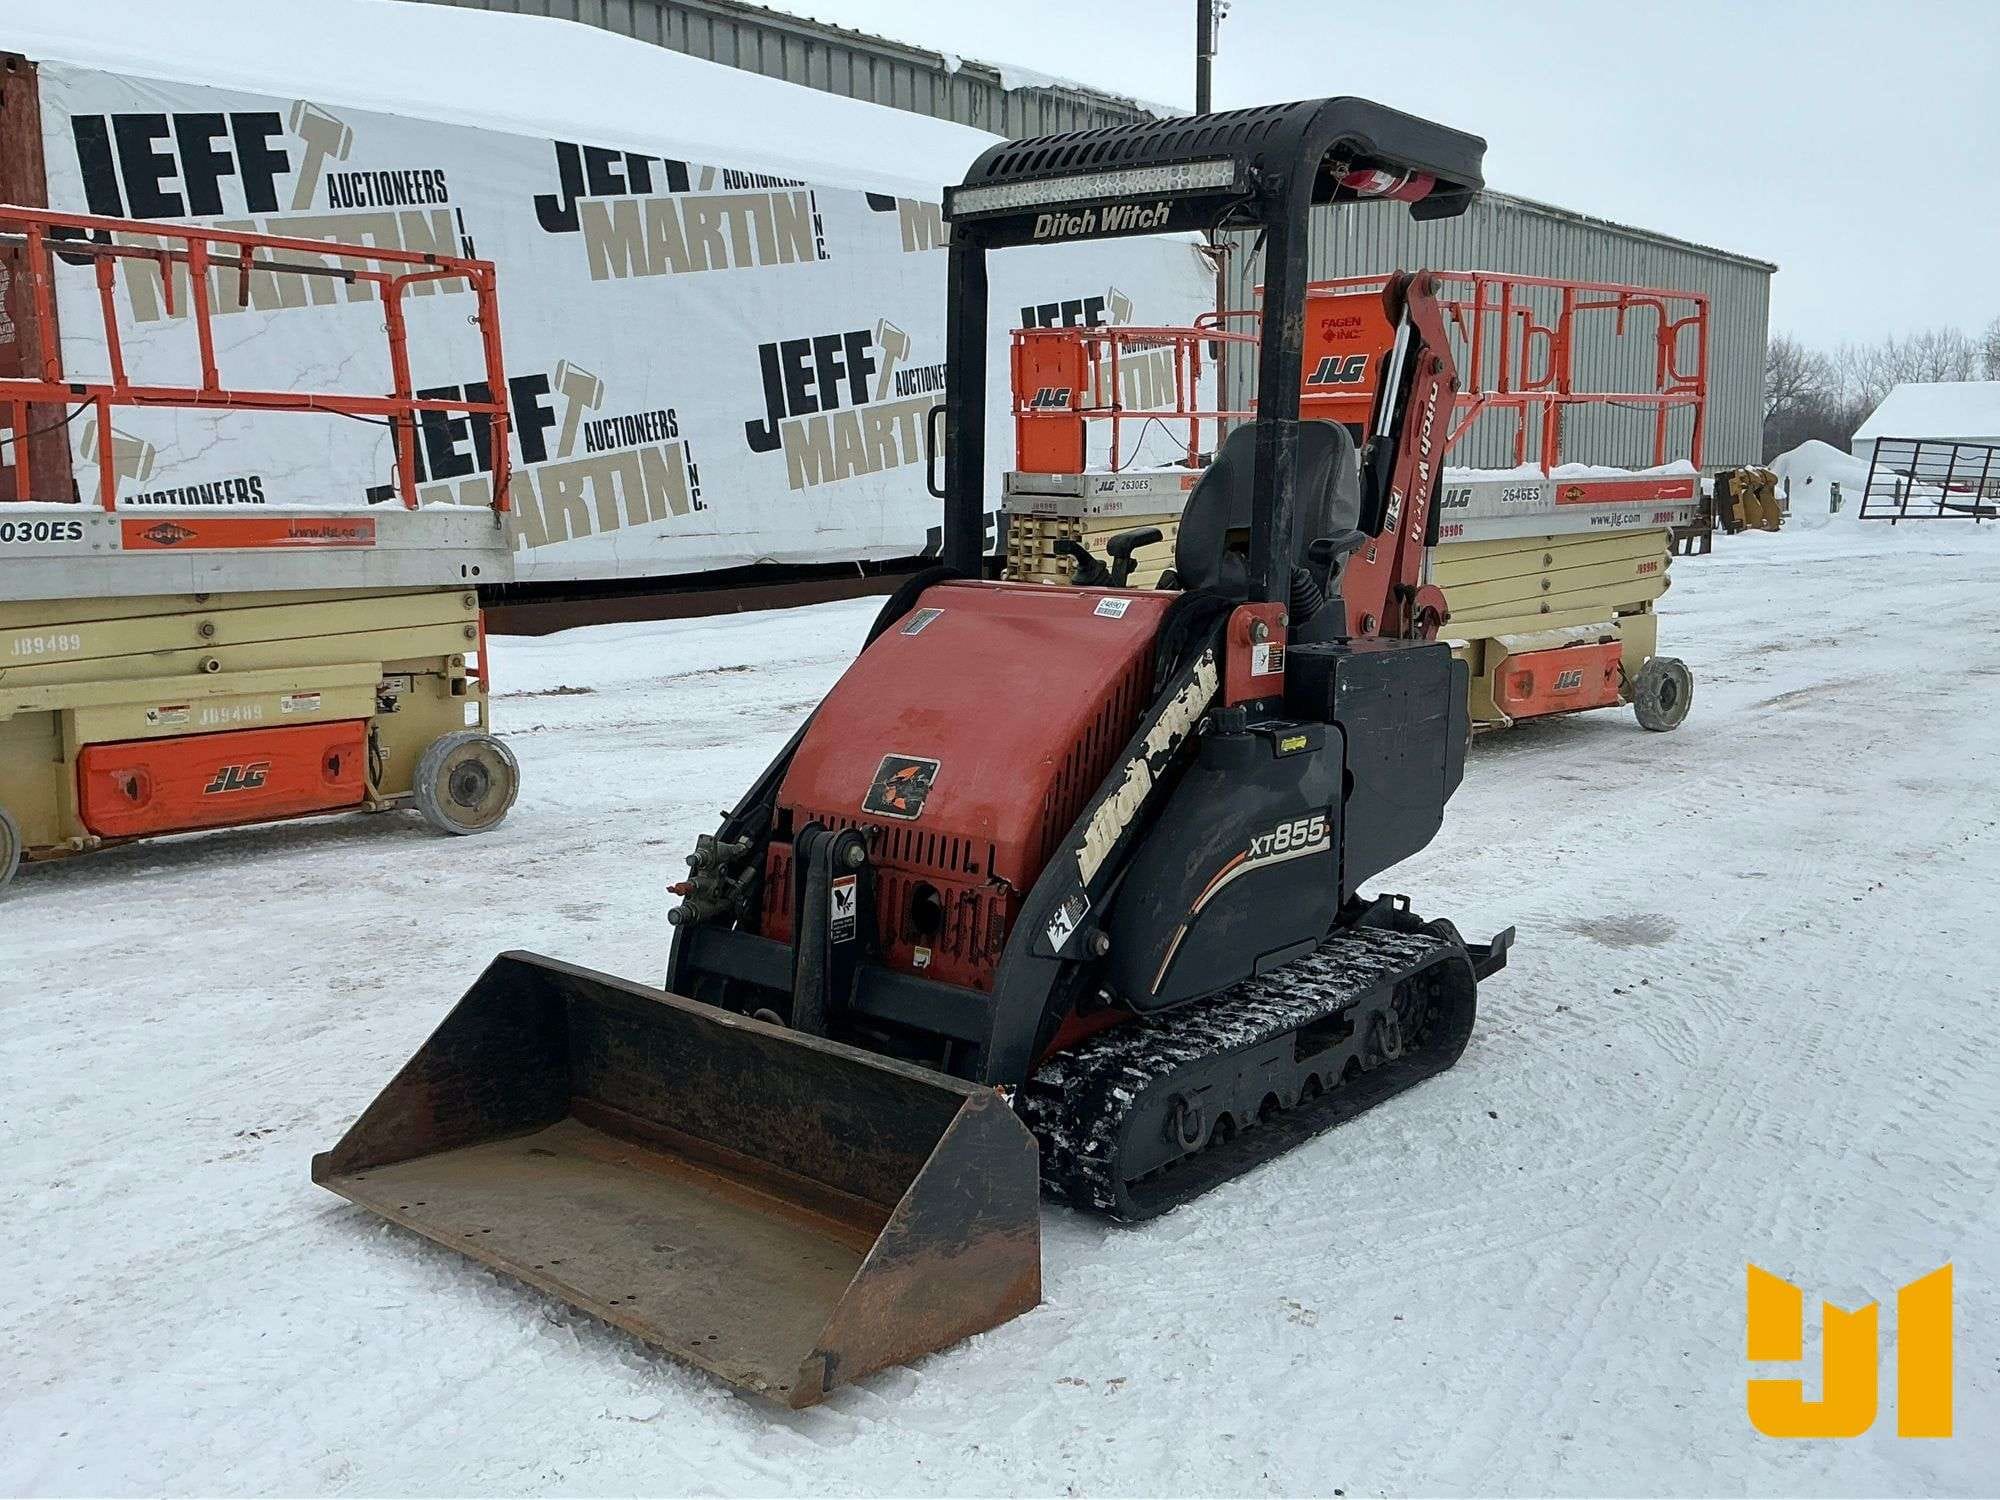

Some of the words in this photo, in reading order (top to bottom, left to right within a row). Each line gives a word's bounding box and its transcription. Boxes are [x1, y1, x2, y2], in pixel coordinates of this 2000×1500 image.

[50, 112, 290, 266] JEFF
[326, 169, 448, 209] AUCTIONEERS
[580, 191, 815, 281] MARTIN
[810, 190, 831, 260] INC.
[1033, 210, 1096, 239] Ditch
[1101, 202, 1170, 232] Witch
[1321, 317, 1361, 328] FAGEN
[1306, 354, 1369, 385] JLG
[745, 330, 877, 453] JEFF
[1030, 387, 1071, 408] JLG
[583, 408, 679, 453] AUCTIONEERS
[684, 440, 708, 512] INC.
[1099, 481, 1115, 492] JLG
[1121, 479, 1149, 491] 2630ES
[1440, 488, 1472, 508] JLG
[1502, 487, 1539, 503] 2646ES
[0, 521, 83, 542] 030ES
[1590, 511, 1641, 528] www.jlg.com
[11, 634, 81, 656] JB9489
[1552, 669, 1584, 690] JLG
[203, 761, 272, 795] JLG
[1249, 815, 1326, 857] XT855
